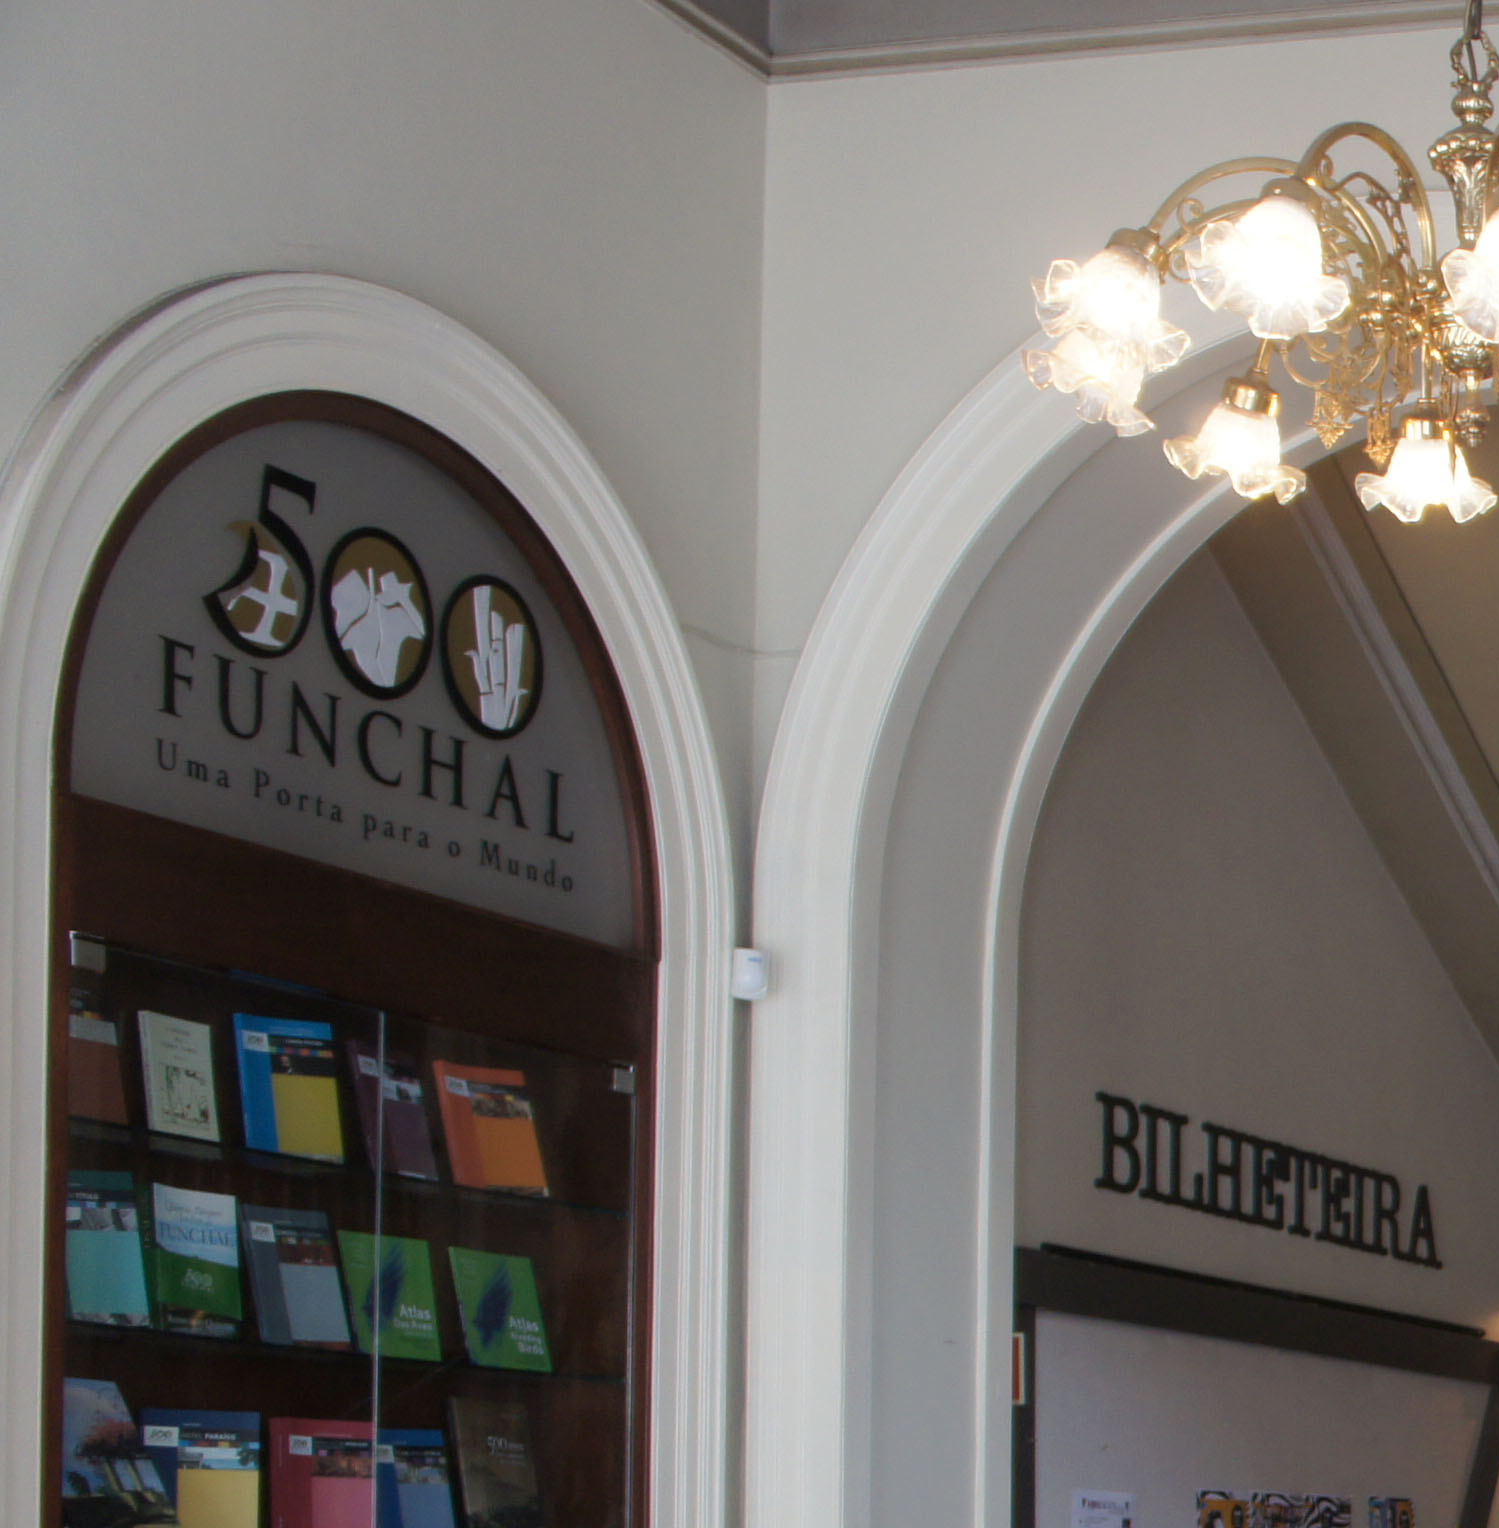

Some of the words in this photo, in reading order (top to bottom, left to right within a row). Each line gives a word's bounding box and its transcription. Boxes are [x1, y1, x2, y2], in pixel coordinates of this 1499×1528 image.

[203, 463, 544, 741] 500
[156, 737, 231, 789] Uma
[253, 767, 344, 824] Porta
[362, 812, 430, 849] para
[447, 840, 462, 858] o
[479, 839, 575, 893] Mundo
[157, 634, 576, 844] FUNCHAL
[1095, 1090, 1443, 1269] BILHETEIRA
[400, 1303, 432, 1321] Atlas
[509, 1315, 539, 1333] Atlas
